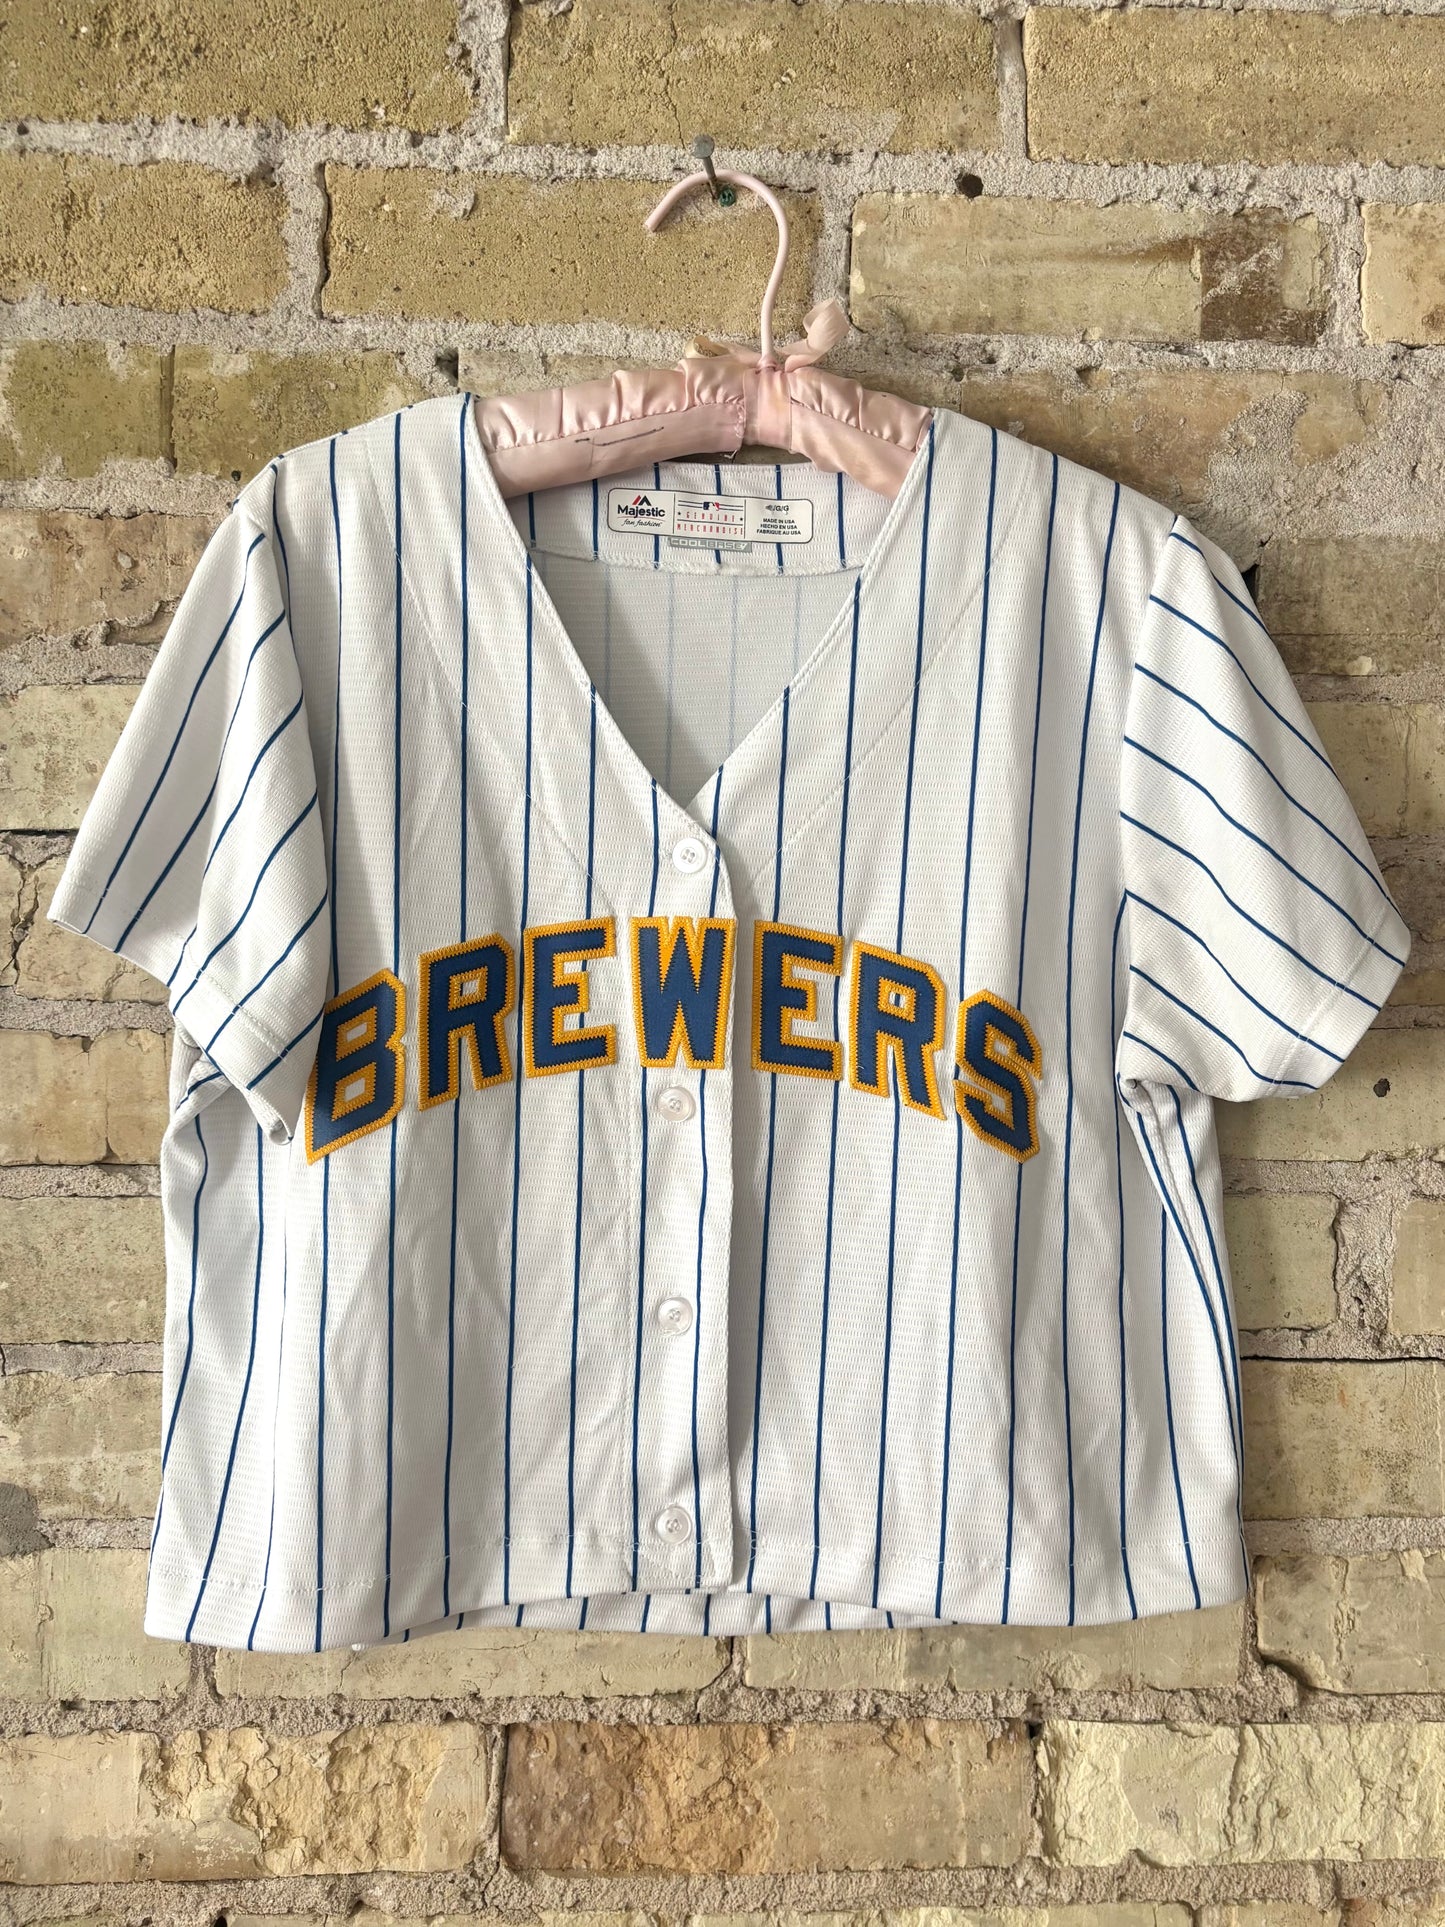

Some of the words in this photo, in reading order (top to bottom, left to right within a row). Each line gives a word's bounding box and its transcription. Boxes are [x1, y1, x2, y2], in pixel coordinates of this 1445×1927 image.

[617, 504, 666, 518] Majestic
[621, 518, 635, 527] fan
[634, 519, 662, 528] fashion
[305, 915, 1044, 1164] BREWERS
